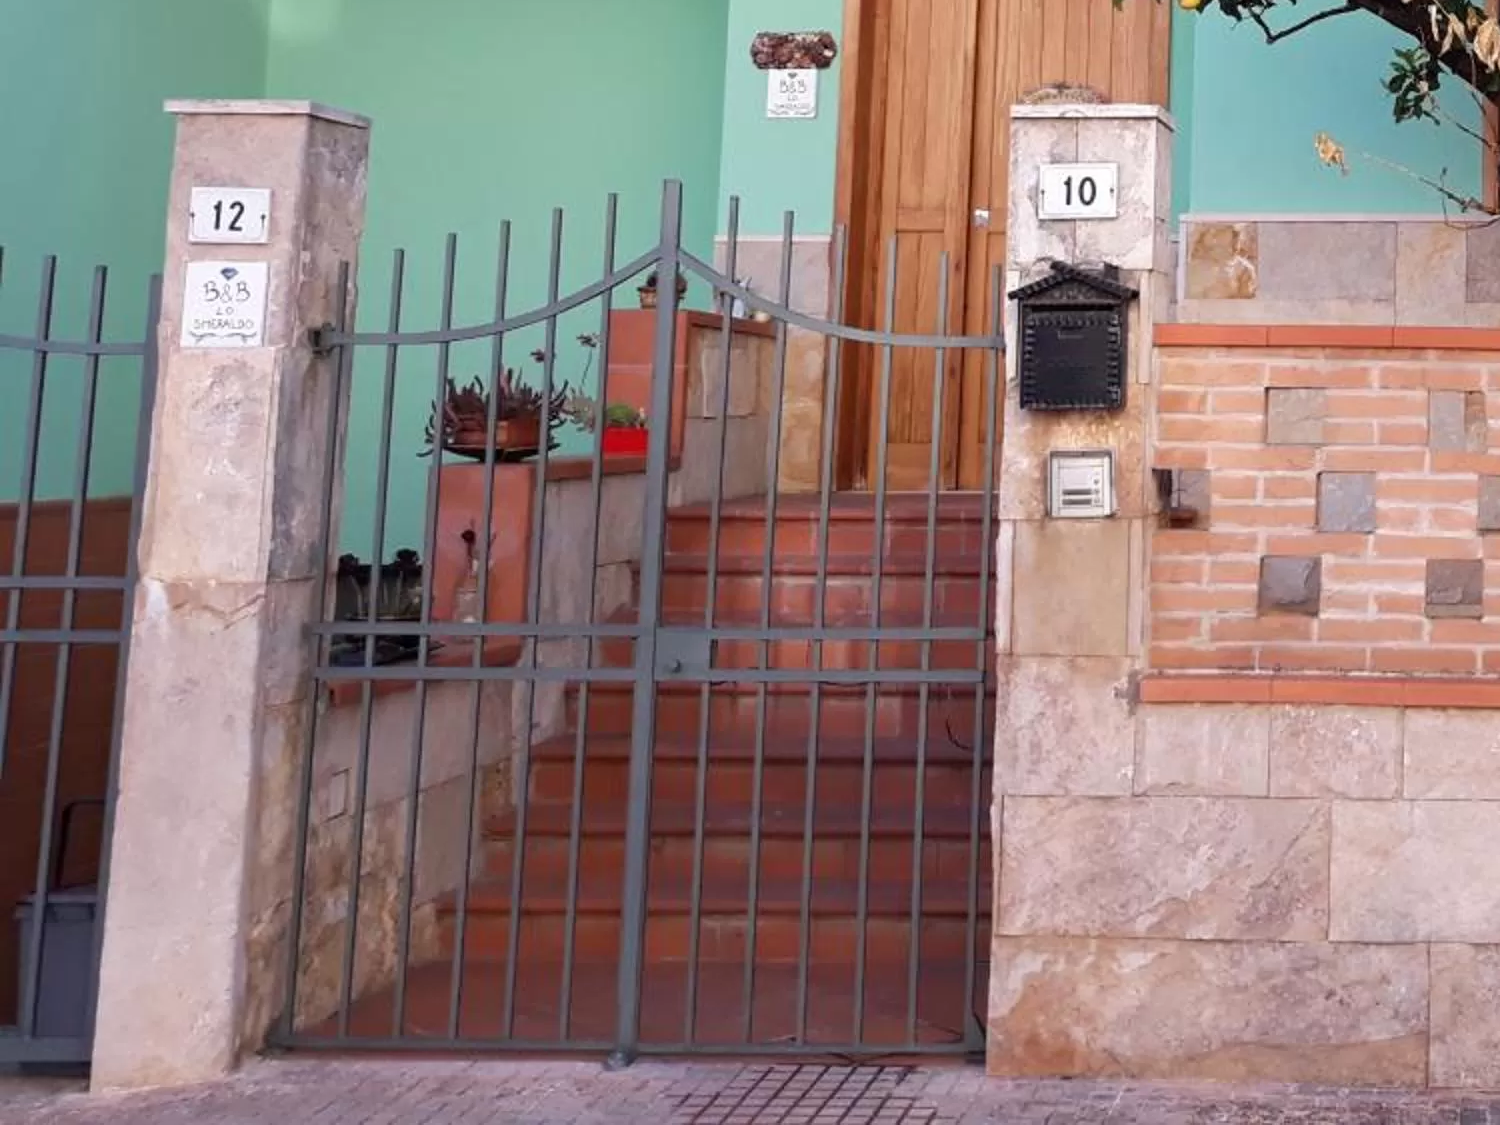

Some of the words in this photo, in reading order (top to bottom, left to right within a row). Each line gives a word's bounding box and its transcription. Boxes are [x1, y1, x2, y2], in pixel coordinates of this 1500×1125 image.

[1063, 175, 1097, 207] 10
[213, 200, 245, 232] 12
[203, 280, 251, 303] B&B
[216, 307, 234, 316] LO
[193, 318, 255, 330] SMERALDO
